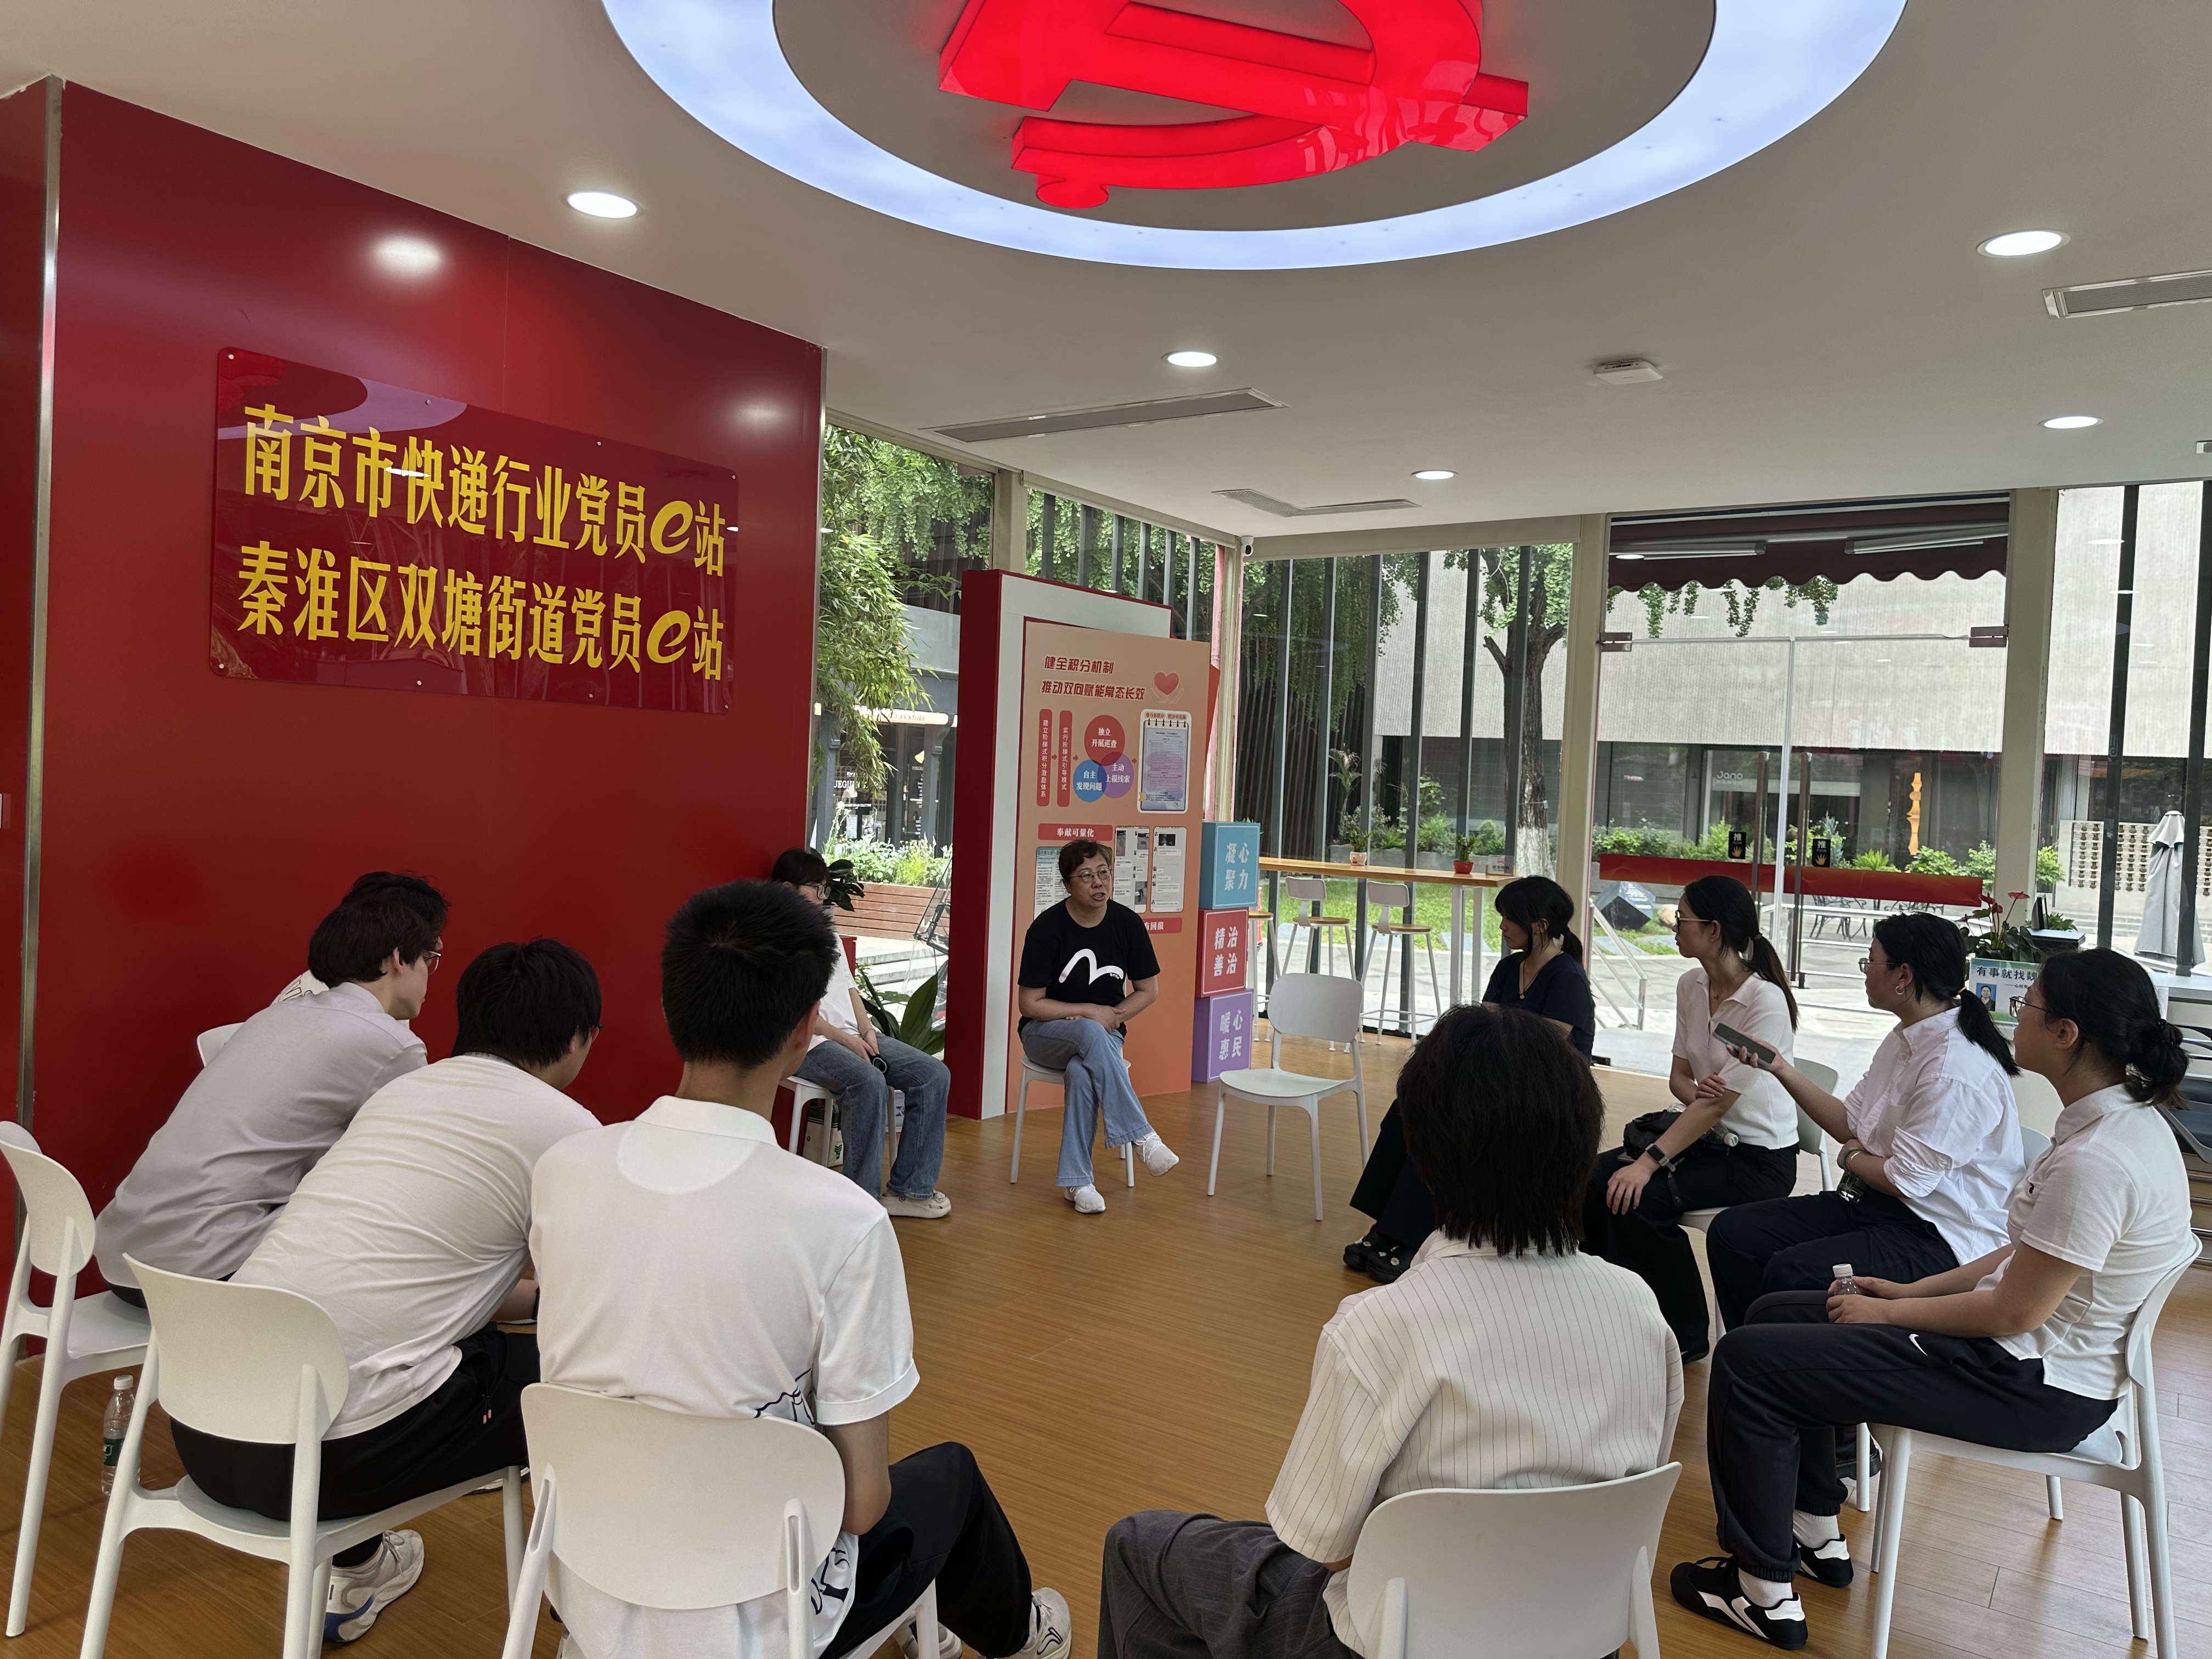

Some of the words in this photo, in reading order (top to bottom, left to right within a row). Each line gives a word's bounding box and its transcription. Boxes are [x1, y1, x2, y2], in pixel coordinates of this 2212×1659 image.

[245, 404, 726, 577] 南京市快递行业党员e站
[238, 540, 724, 681] 秦淮区双塘街道党员e站
[1044, 656, 1114, 674] 健全积分机制
[1041, 680, 1146, 700] 推动双向赋能常态长效
[1098, 727, 1111, 736] 独立
[1091, 739, 1117, 748] 开展巡查
[1084, 770, 1096, 779] 自主
[1111, 763, 1125, 772] 主动
[1076, 782, 1103, 791] 发现问题
[1105, 774, 1131, 783] 上报线索
[1057, 827, 1094, 838] 奉献可量化
[1733, 832, 1742, 841] 推
[1225, 843, 1249, 864] 凝心
[1817, 840, 1826, 849] 推
[1224, 869, 1249, 891] 聚力
[1214, 926, 1238, 950] 精治
[1214, 952, 1238, 977] 善治
[1220, 1009, 1243, 1034] 暖心
[1218, 1036, 1243, 1060] 惠民
